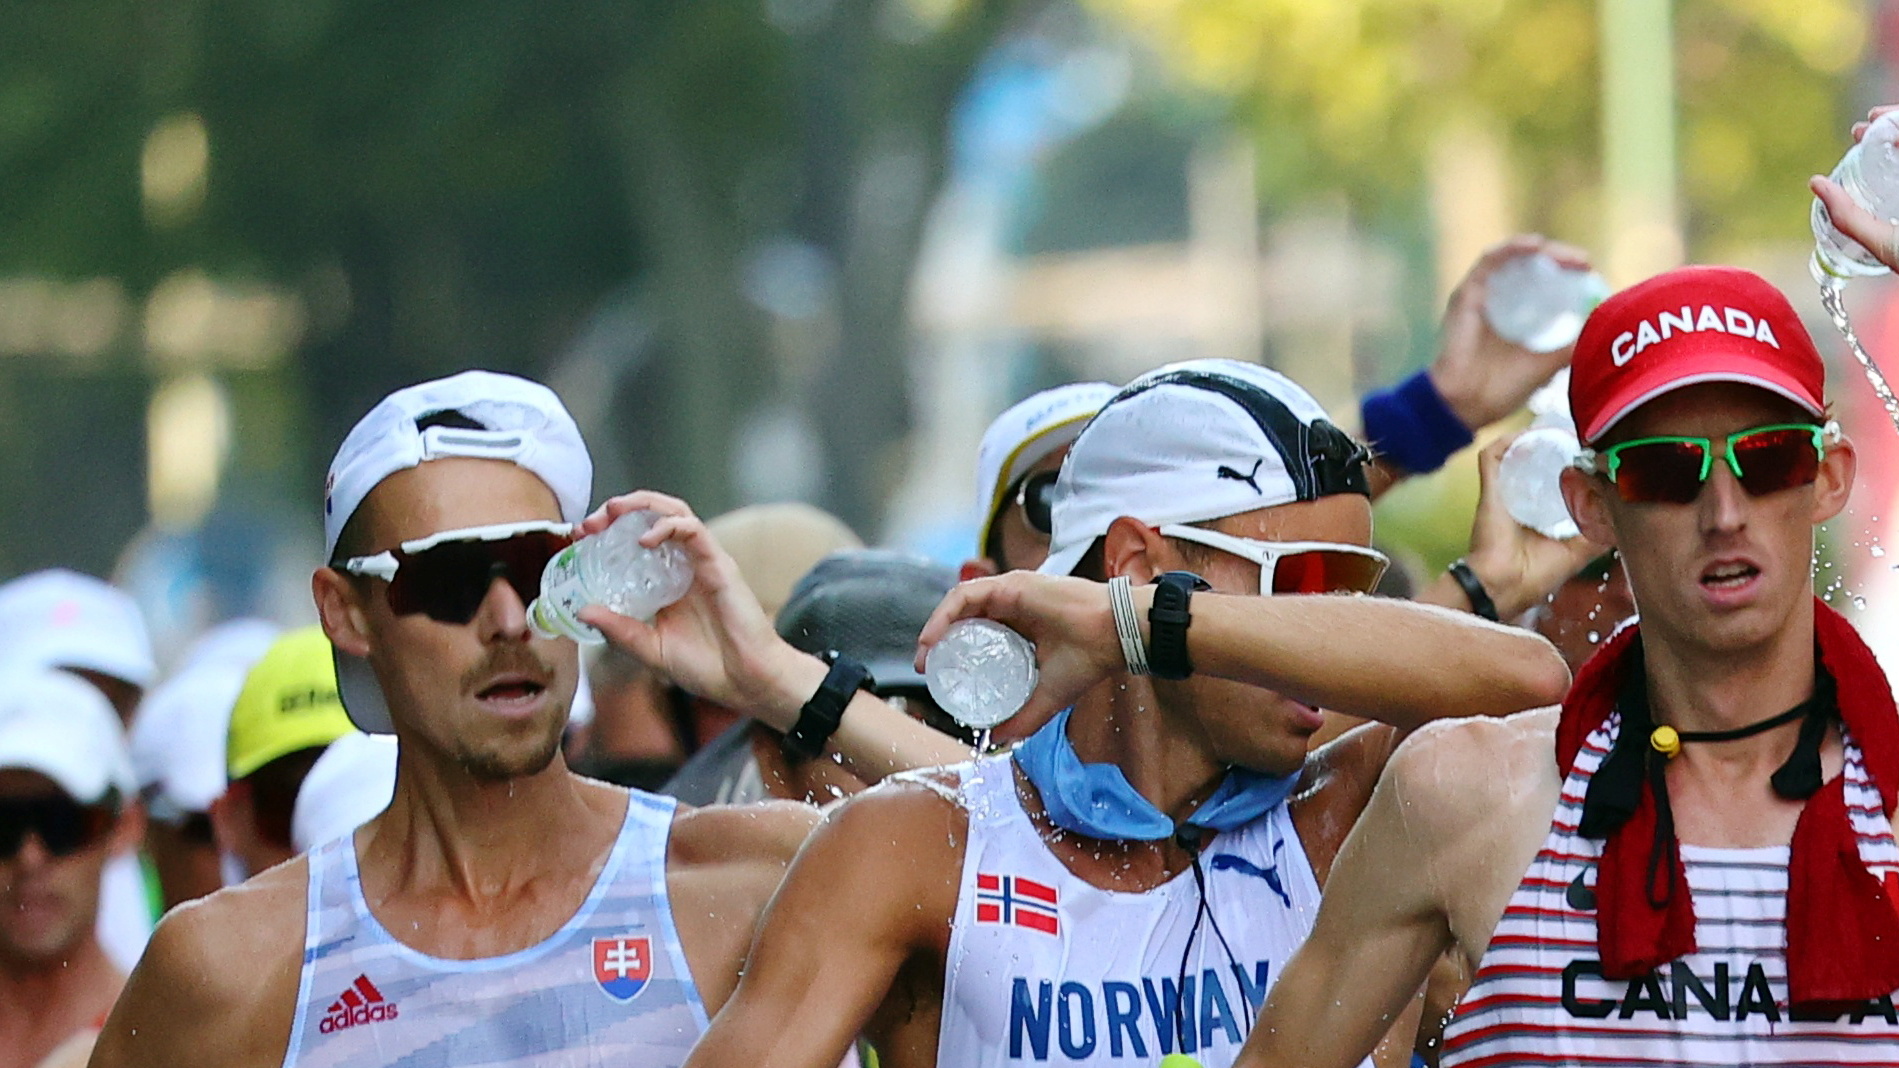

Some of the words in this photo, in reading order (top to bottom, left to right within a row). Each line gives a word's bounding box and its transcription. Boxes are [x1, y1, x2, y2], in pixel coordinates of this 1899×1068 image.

[1611, 305, 1780, 367] CANADA
[319, 1002, 398, 1034] adidas
[1009, 960, 1269, 1061] NORWAY
